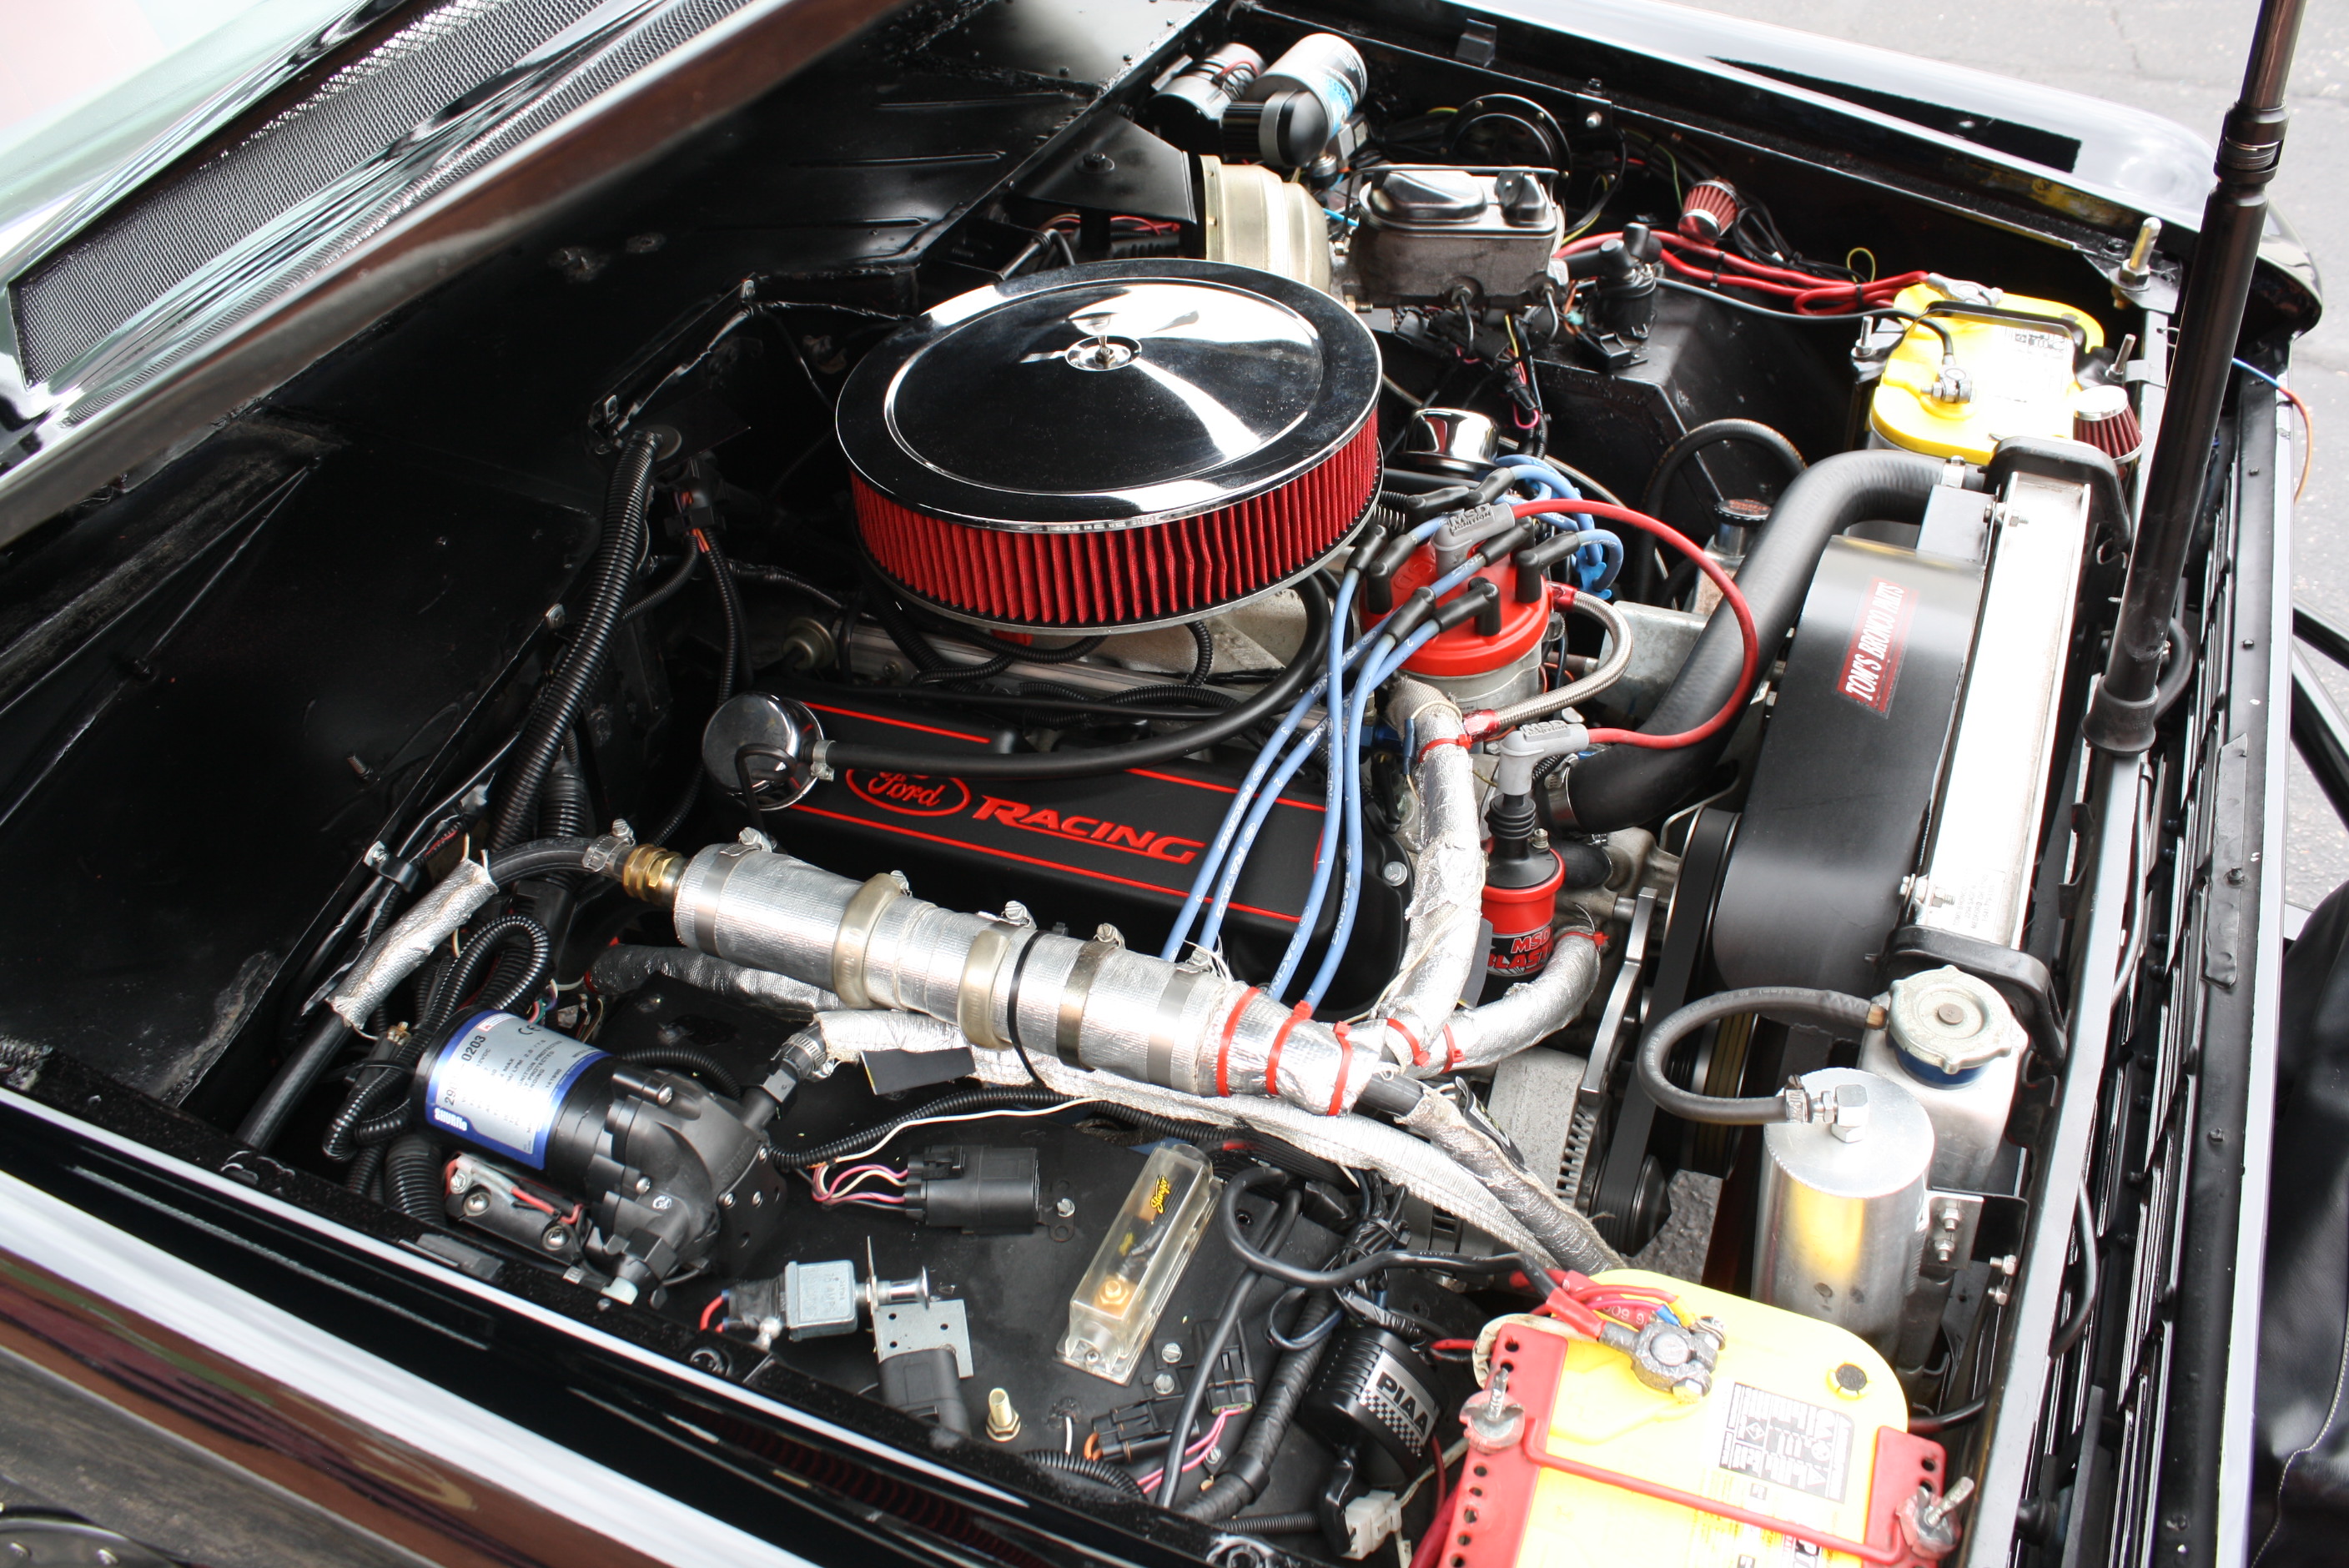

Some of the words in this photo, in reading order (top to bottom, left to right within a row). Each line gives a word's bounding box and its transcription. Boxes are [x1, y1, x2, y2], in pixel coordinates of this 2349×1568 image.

[1448, 502, 1491, 526] MSD
[1872, 581, 1905, 616] PARTS
[1859, 609, 1896, 661] BRONCO
[1844, 653, 1883, 701] TOM'S
[1280, 726, 1290, 736] 3
[1520, 720, 1567, 734] MSD
[1273, 776, 1284, 788] 2
[867, 768, 948, 808] Ford
[971, 793, 1208, 865] RACING
[1217, 783, 1254, 853] RACING
[1330, 871, 1351, 946] RACING
[1511, 926, 1552, 954] MSD
[1150, 1173, 1171, 1214] Stinger
[1376, 1370, 1429, 1435] PIAA
